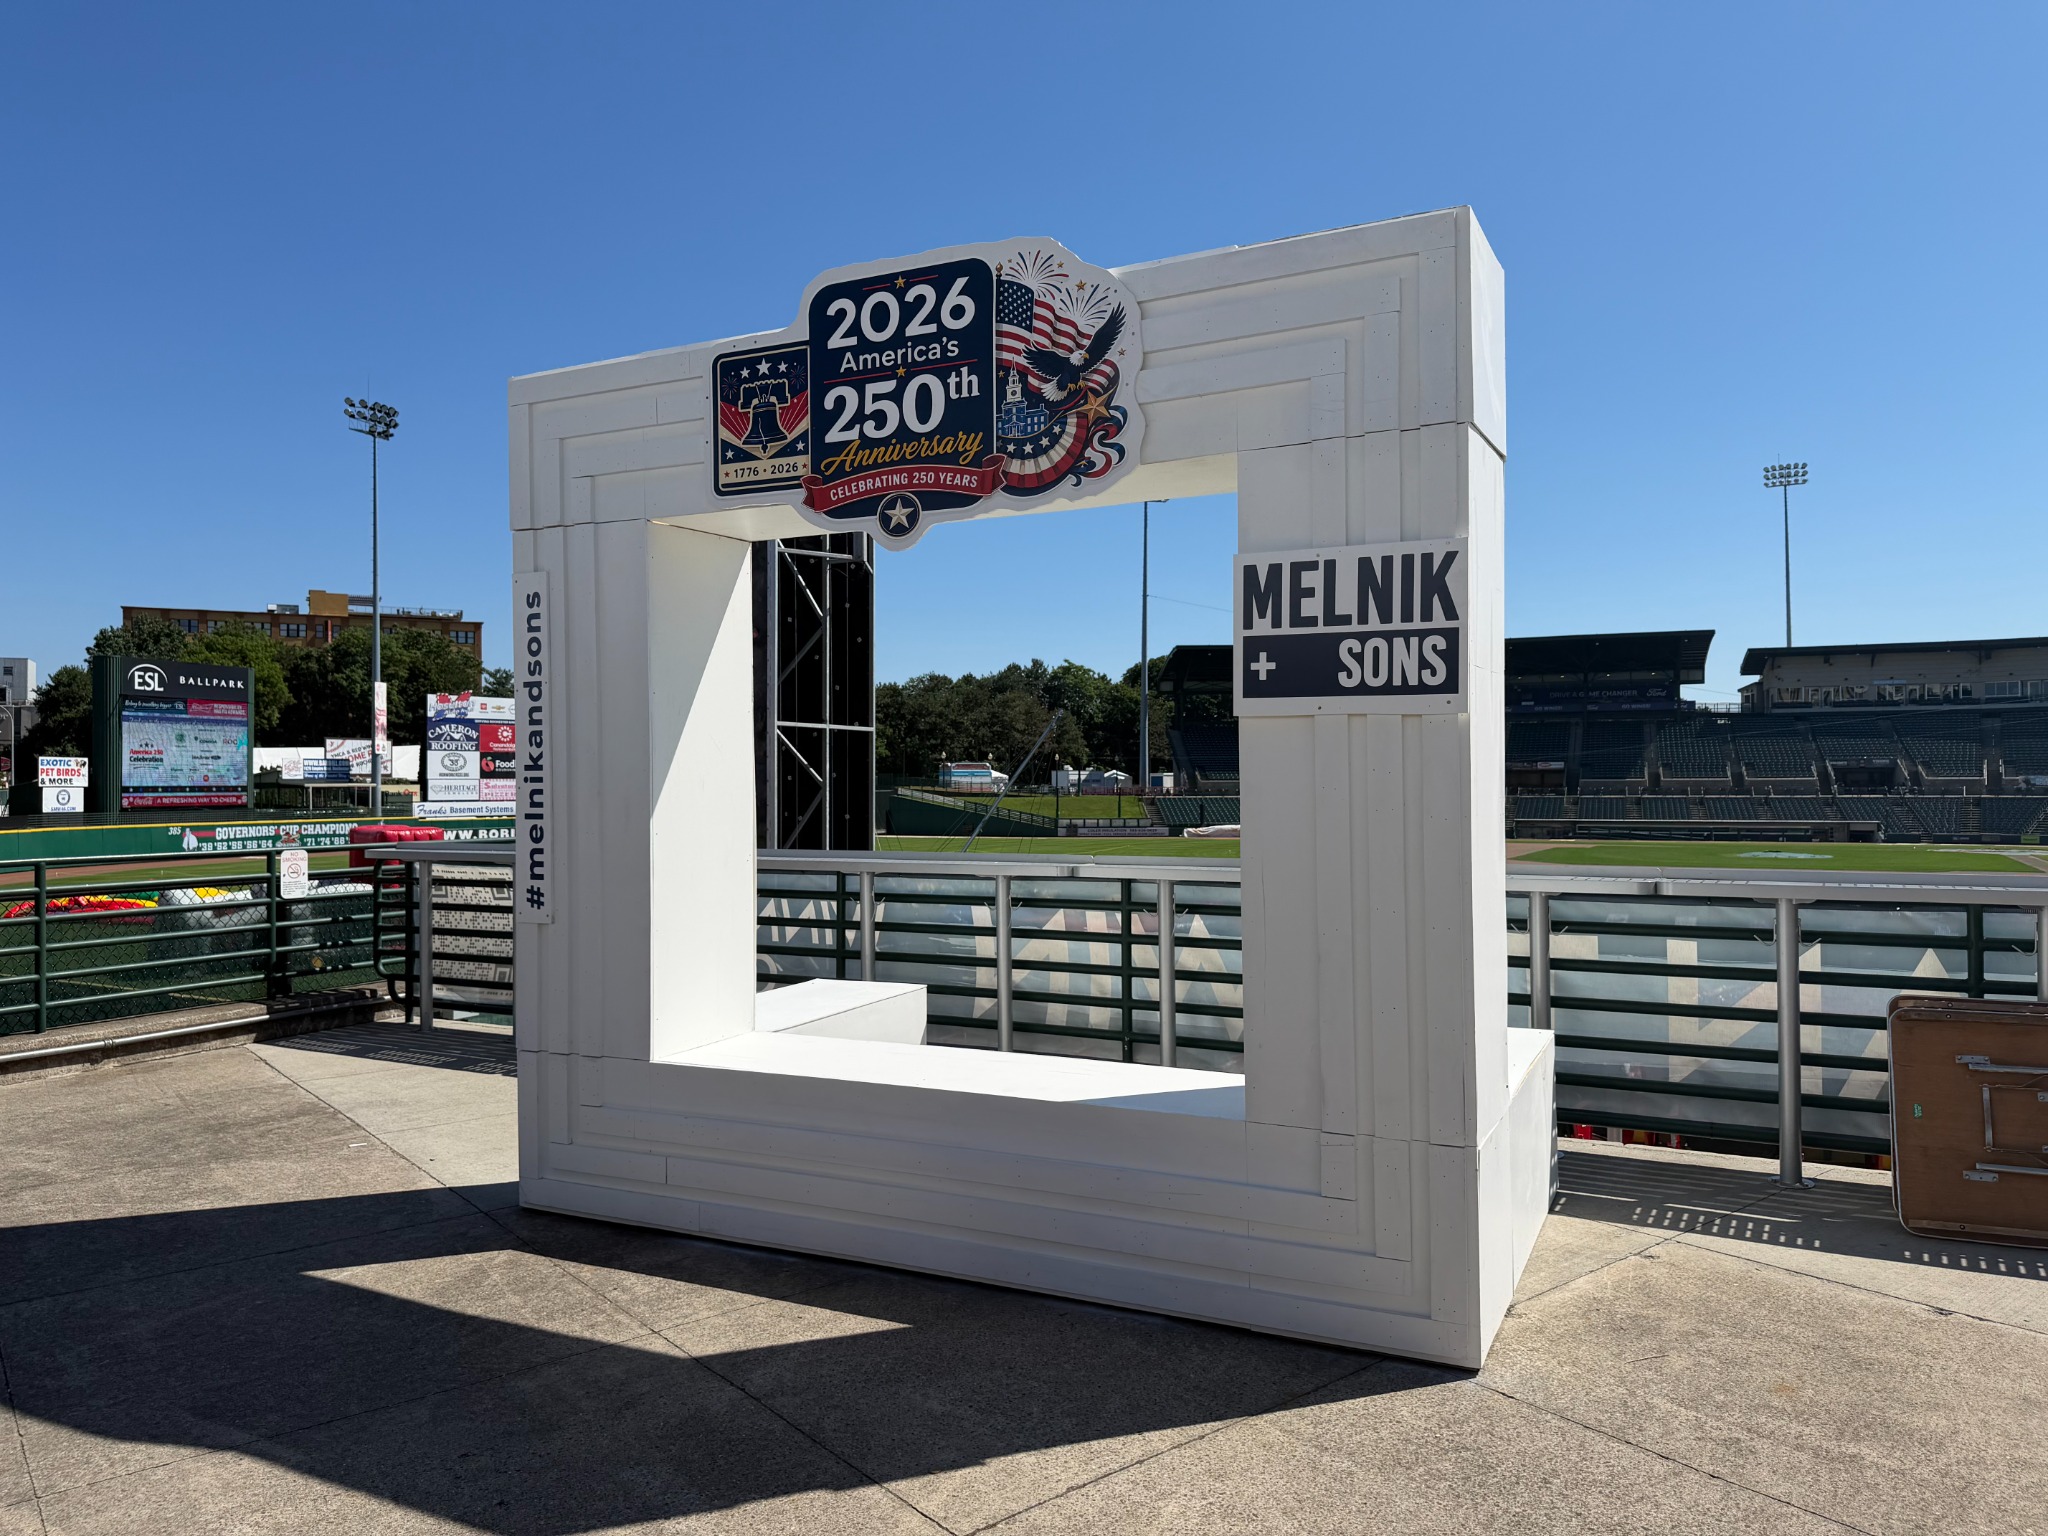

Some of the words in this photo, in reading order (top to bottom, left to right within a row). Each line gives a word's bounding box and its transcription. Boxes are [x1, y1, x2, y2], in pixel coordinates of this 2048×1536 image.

[825, 275, 977, 350] 2026
[839, 335, 960, 374] America's
[823, 365, 981, 445] 250th
[820, 428, 985, 475] Anniversary
[733, 464, 760, 479] 1776
[769, 460, 799, 476] 2026
[829, 474, 909, 502] CELEBRATING
[911, 471, 936, 488] 250
[938, 472, 979, 489] YEARS
[1242, 550, 1460, 631] MELNIK
[1337, 634, 1448, 688] SONS
[134, 670, 164, 691] ESL
[179, 675, 245, 689] BALLPARK
[1602, 689, 1638, 698] CHANGER
[1646, 688, 1667, 697] Ford
[428, 724, 479, 739] CAMERON
[431, 742, 476, 750] ROOFING
[522, 590, 545, 911] #melnikandsons
[40, 759, 72, 767] EXOTIC
[40, 768, 55, 777] PET
[56, 768, 81, 777] BIRDS
[40, 777, 46, 785] &
[450, 806, 484, 814] Basement
[485, 805, 514, 814] Systems
[168, 826, 182, 836] 385
[215, 824, 278, 841] GOVERNORS'
[280, 824, 300, 836] CUP
[214, 841, 228, 850] '52
[304, 837, 315, 846] '71
[317, 837, 331, 846] '74
